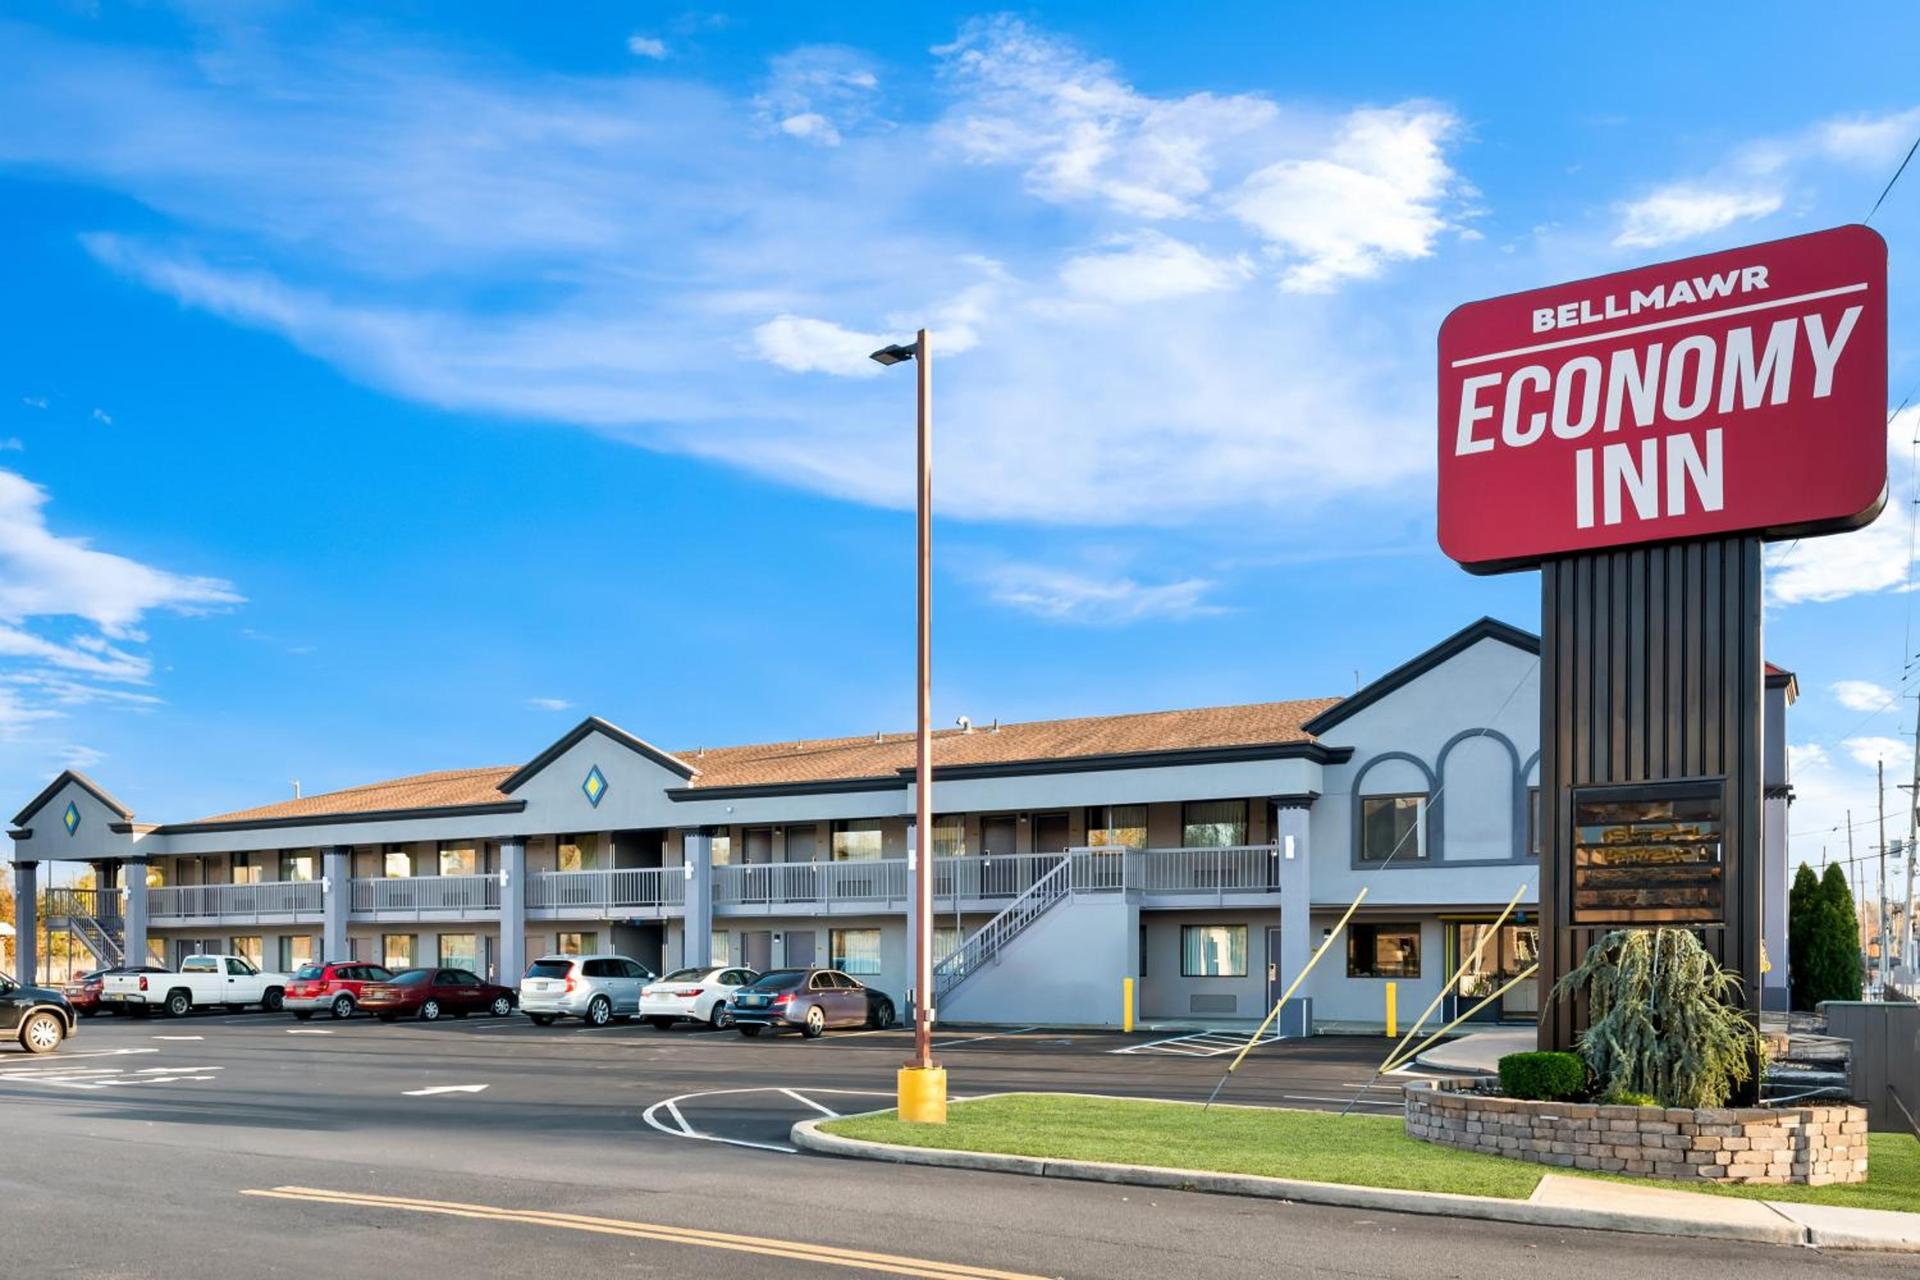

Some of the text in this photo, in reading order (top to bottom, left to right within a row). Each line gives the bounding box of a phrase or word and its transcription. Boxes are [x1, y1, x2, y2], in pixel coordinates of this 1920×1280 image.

[1533, 266, 1769, 333] BELLMAWR
[1456, 306, 1863, 456] ECONOMY
[1576, 428, 1724, 529] INN
